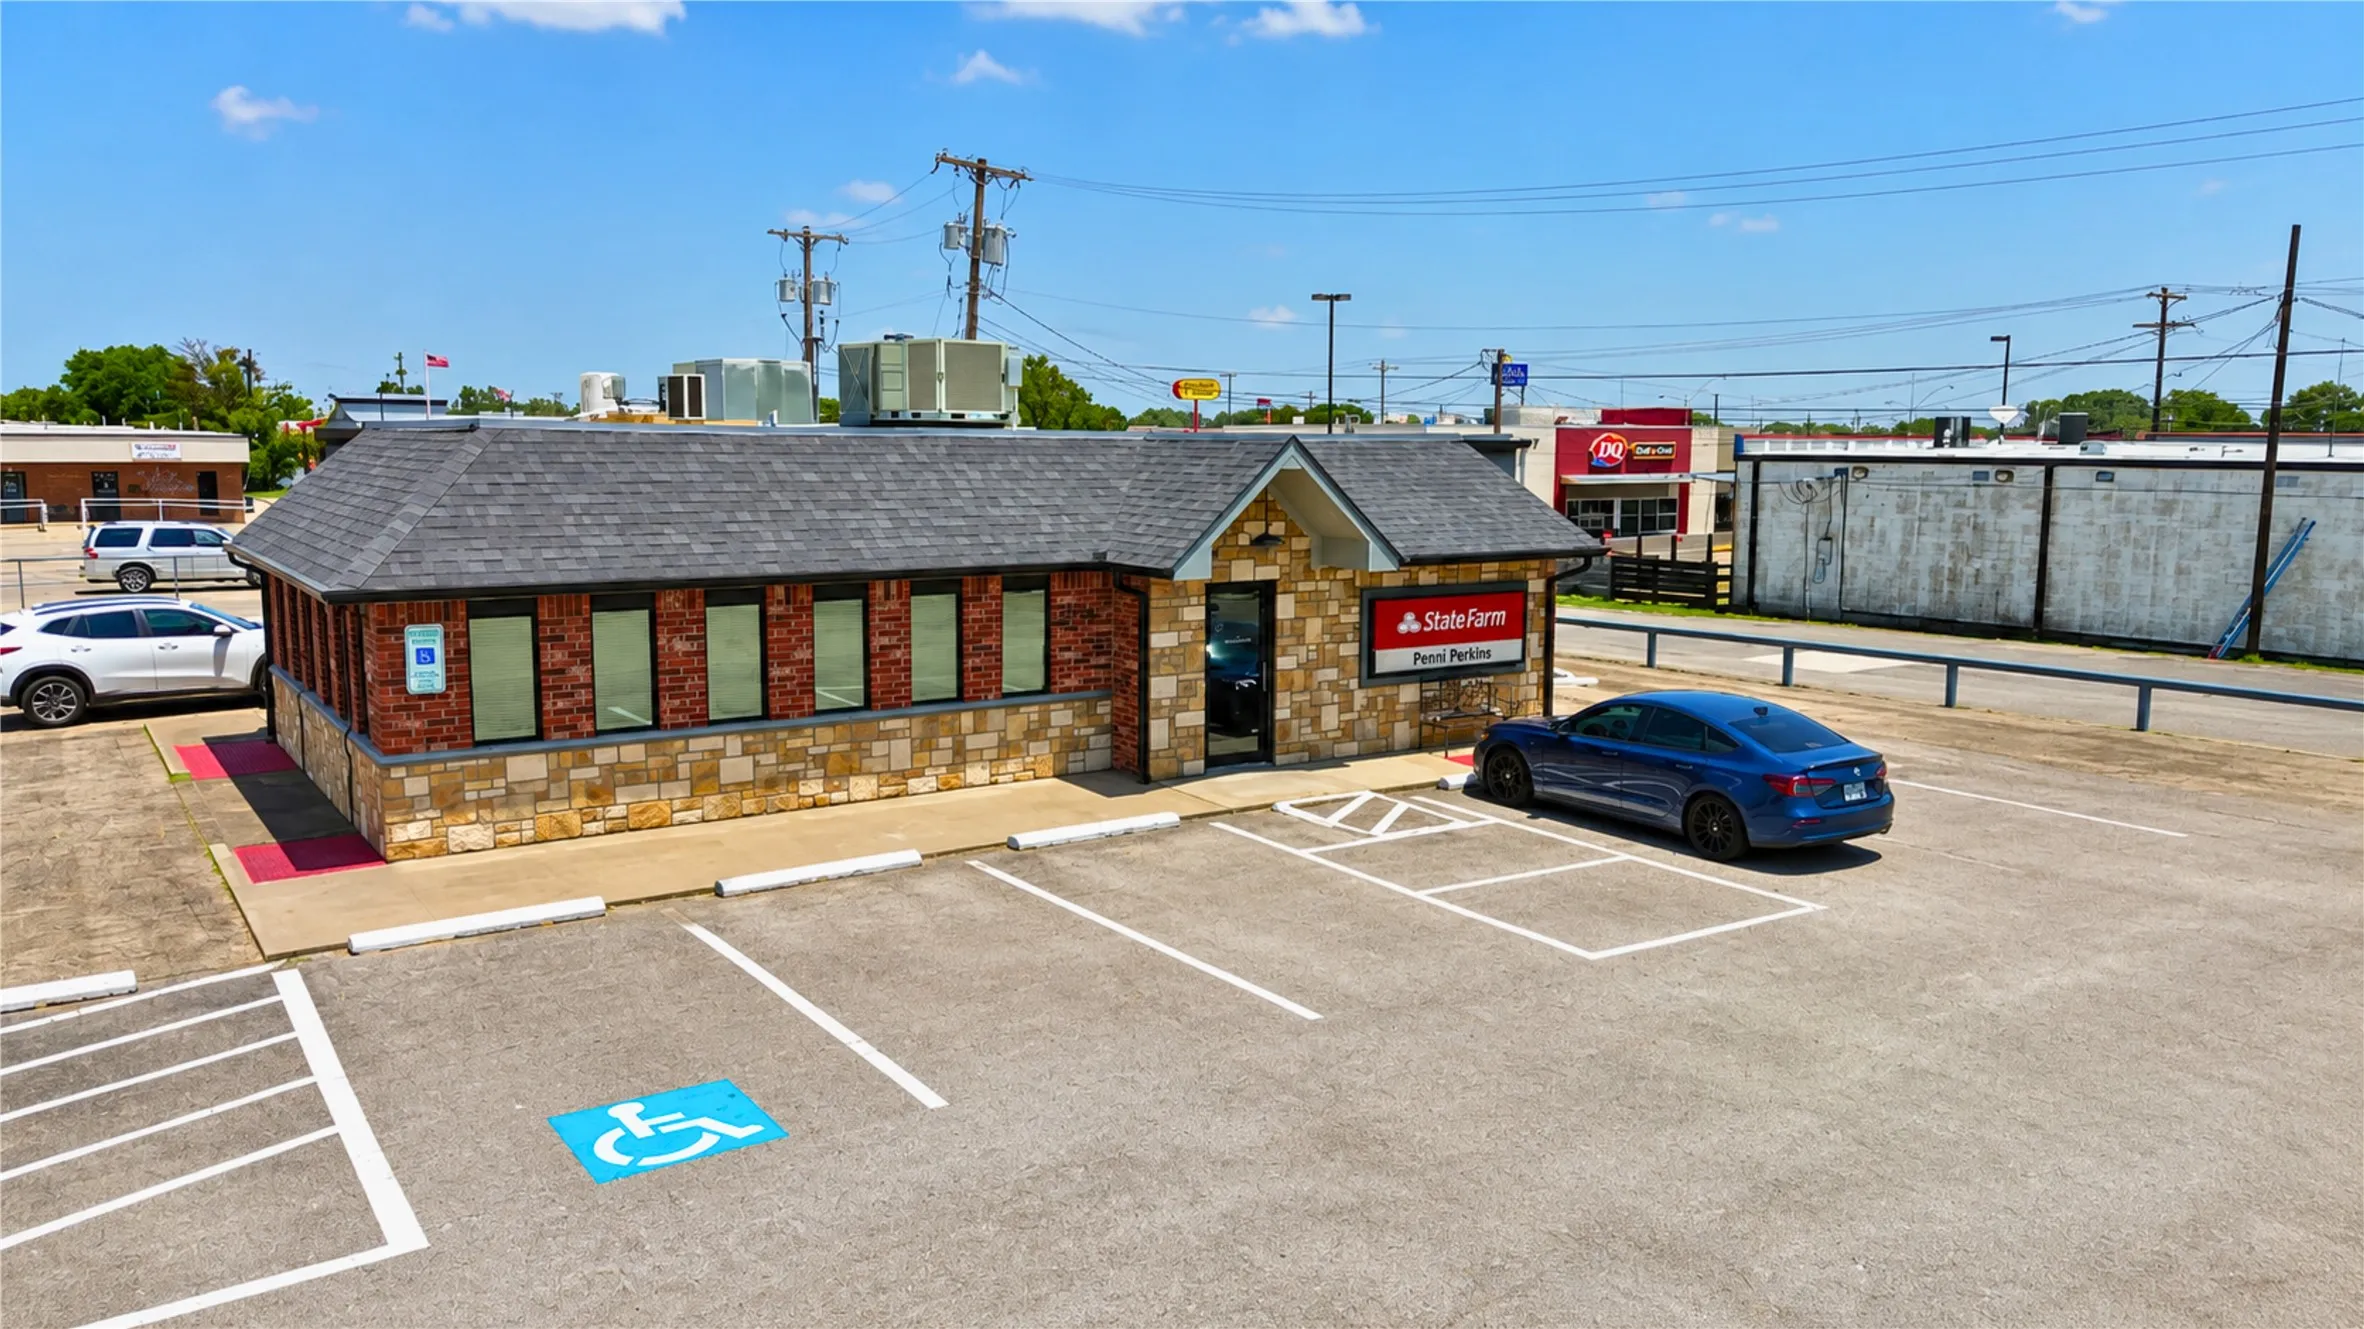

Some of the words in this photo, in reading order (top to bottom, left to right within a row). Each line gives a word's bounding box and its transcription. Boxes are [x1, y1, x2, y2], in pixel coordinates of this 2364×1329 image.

[1598, 441, 1623, 460] DQ
[1413, 648, 1446, 665] Penni
[1450, 646, 1492, 662] Perkins
